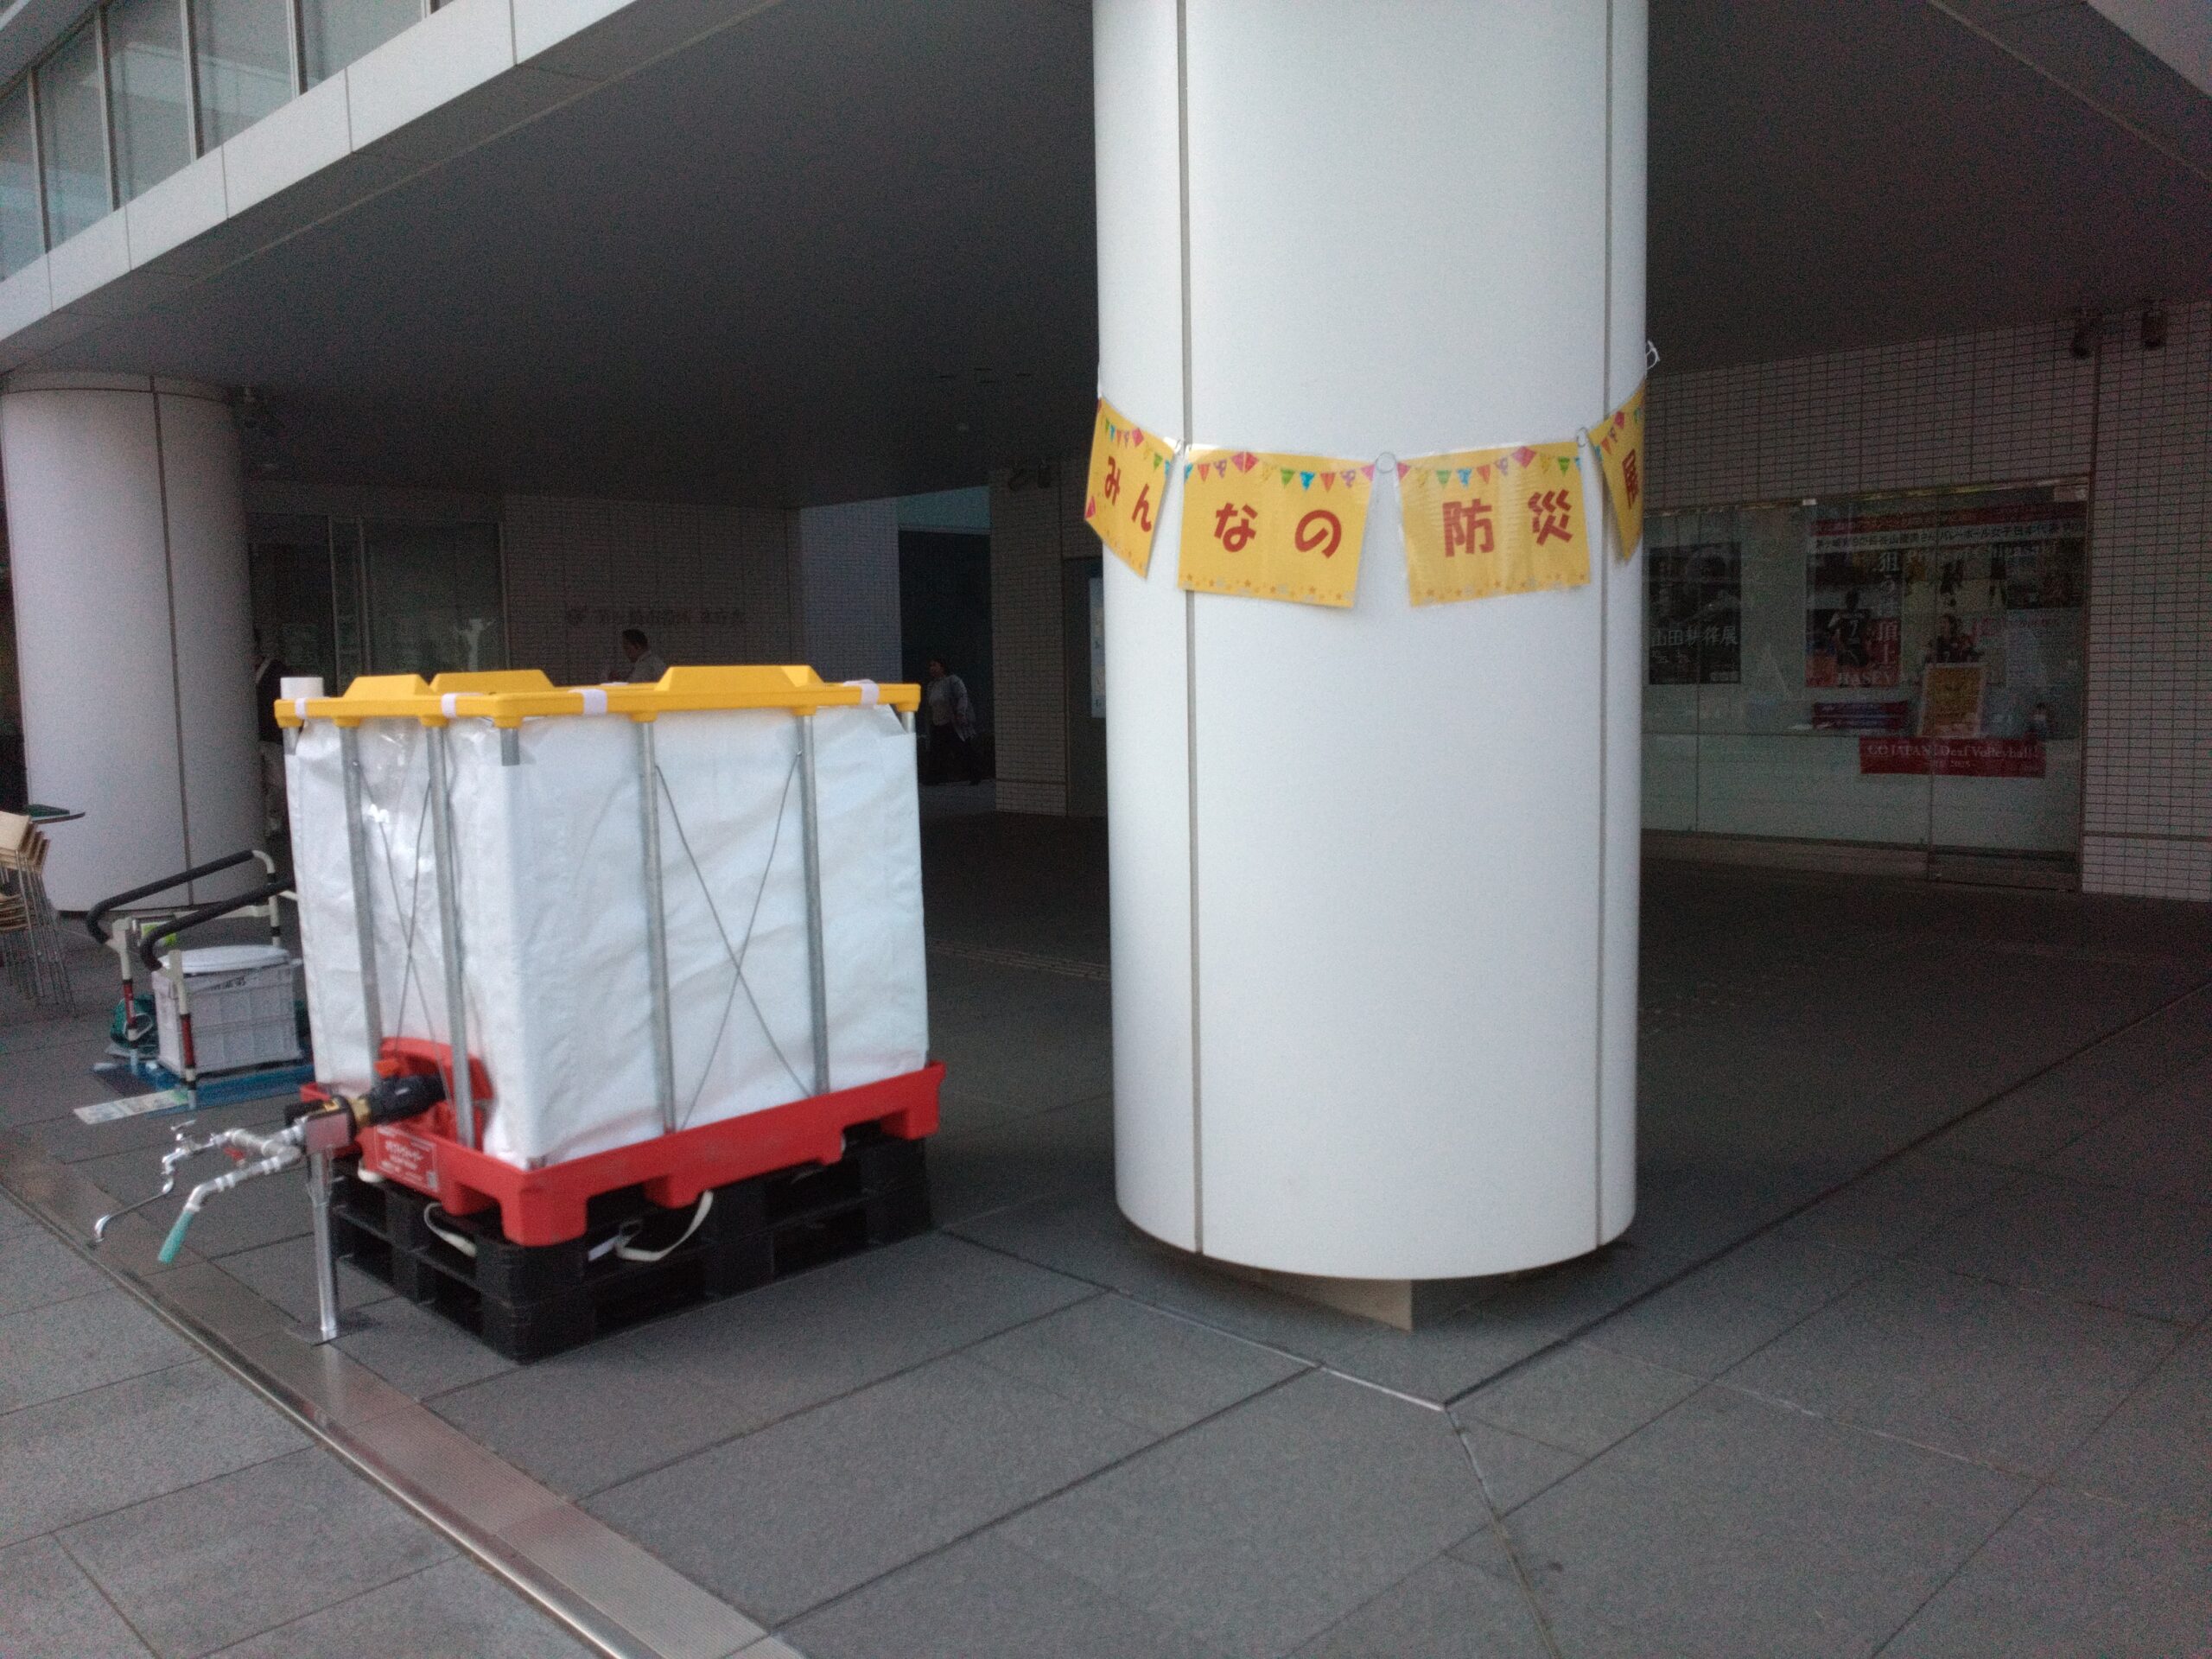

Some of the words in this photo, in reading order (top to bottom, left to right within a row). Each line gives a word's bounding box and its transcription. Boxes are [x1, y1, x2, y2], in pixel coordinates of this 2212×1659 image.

[1103, 455, 1153, 533] みん
[1214, 502, 1342, 559] なの
[1441, 489, 1573, 557] 防災
